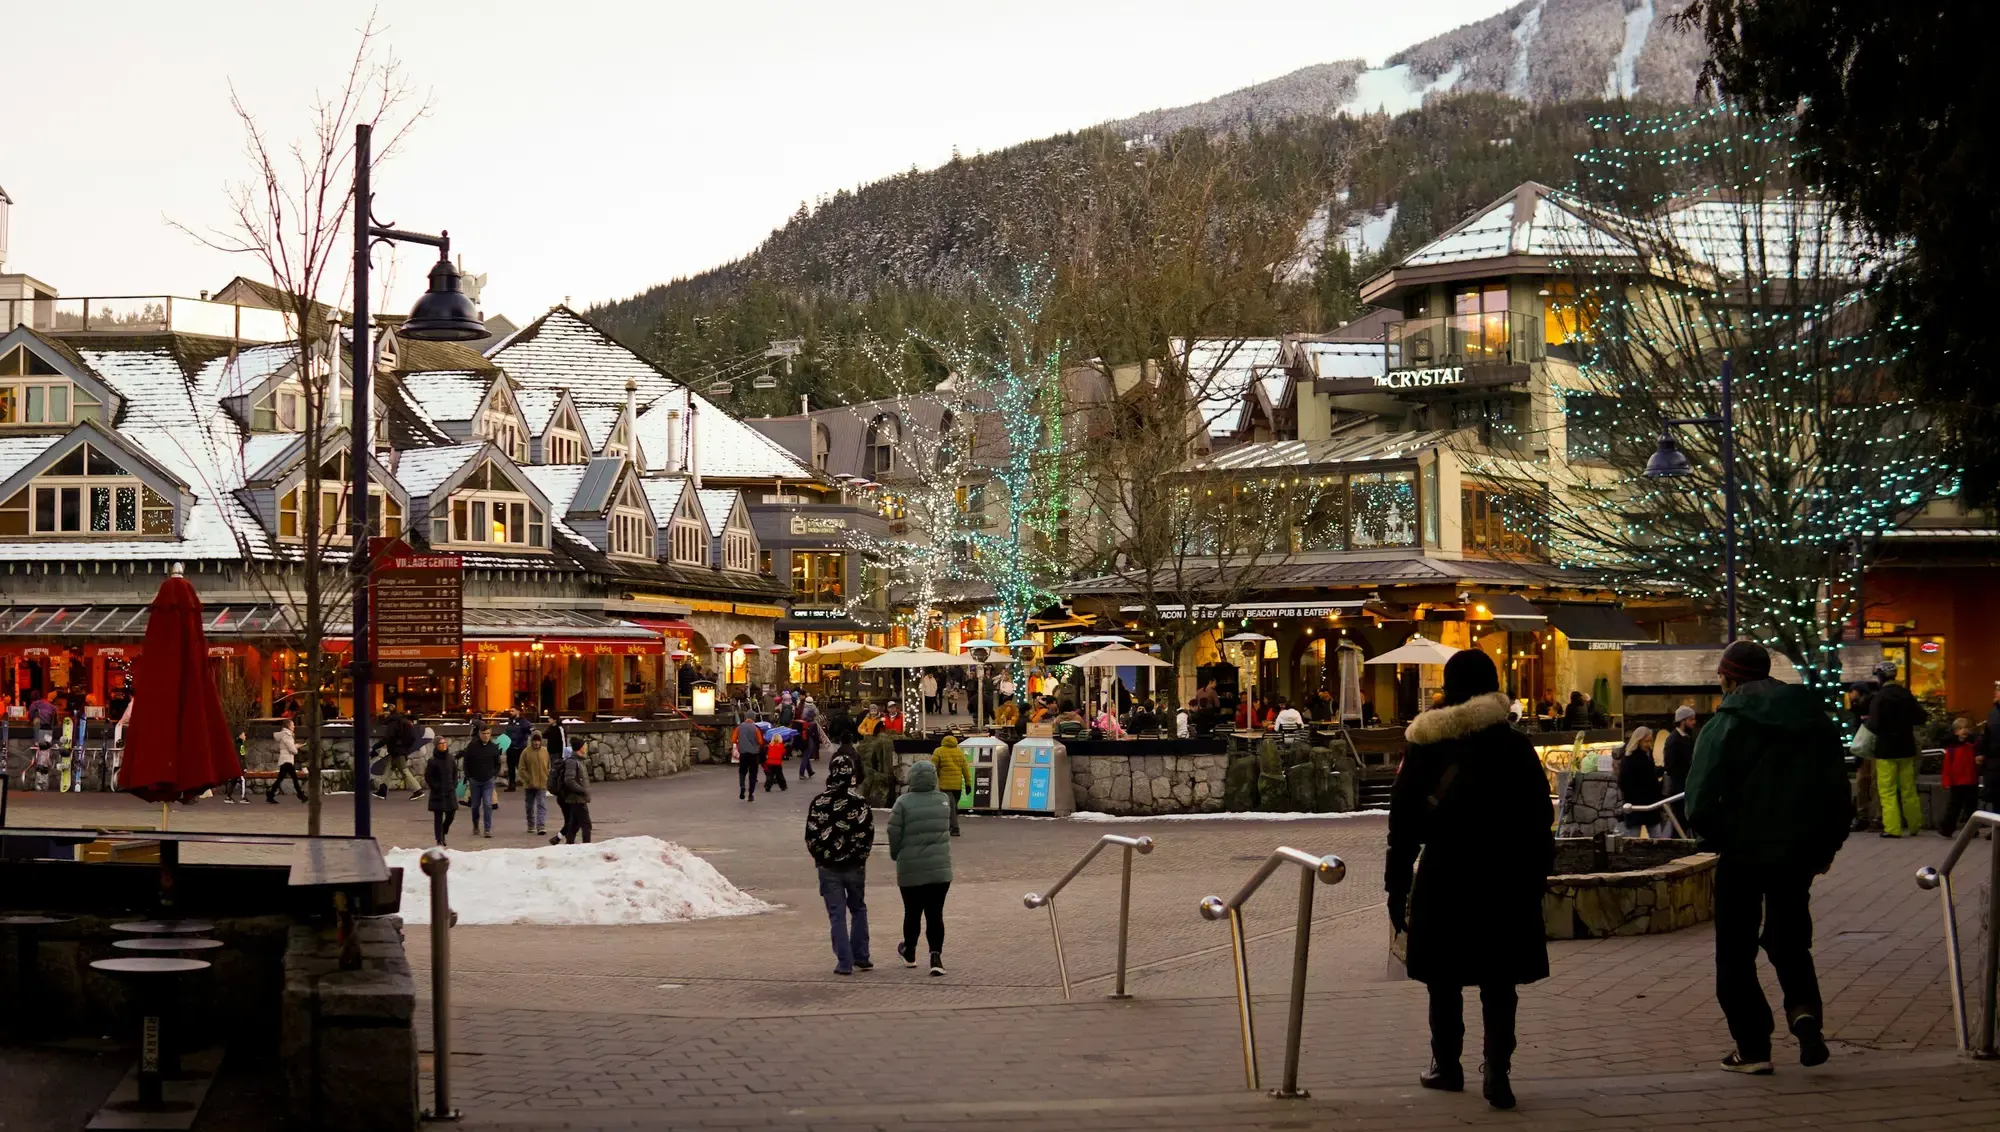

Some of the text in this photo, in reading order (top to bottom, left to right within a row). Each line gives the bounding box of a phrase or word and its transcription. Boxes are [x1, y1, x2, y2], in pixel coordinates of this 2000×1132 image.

[1372, 367, 1465, 388] The CRYSTAL
[395, 557, 459, 568] VILLAGE CENTRE
[1246, 607, 1335, 618] BEACON PUB & EATERY
